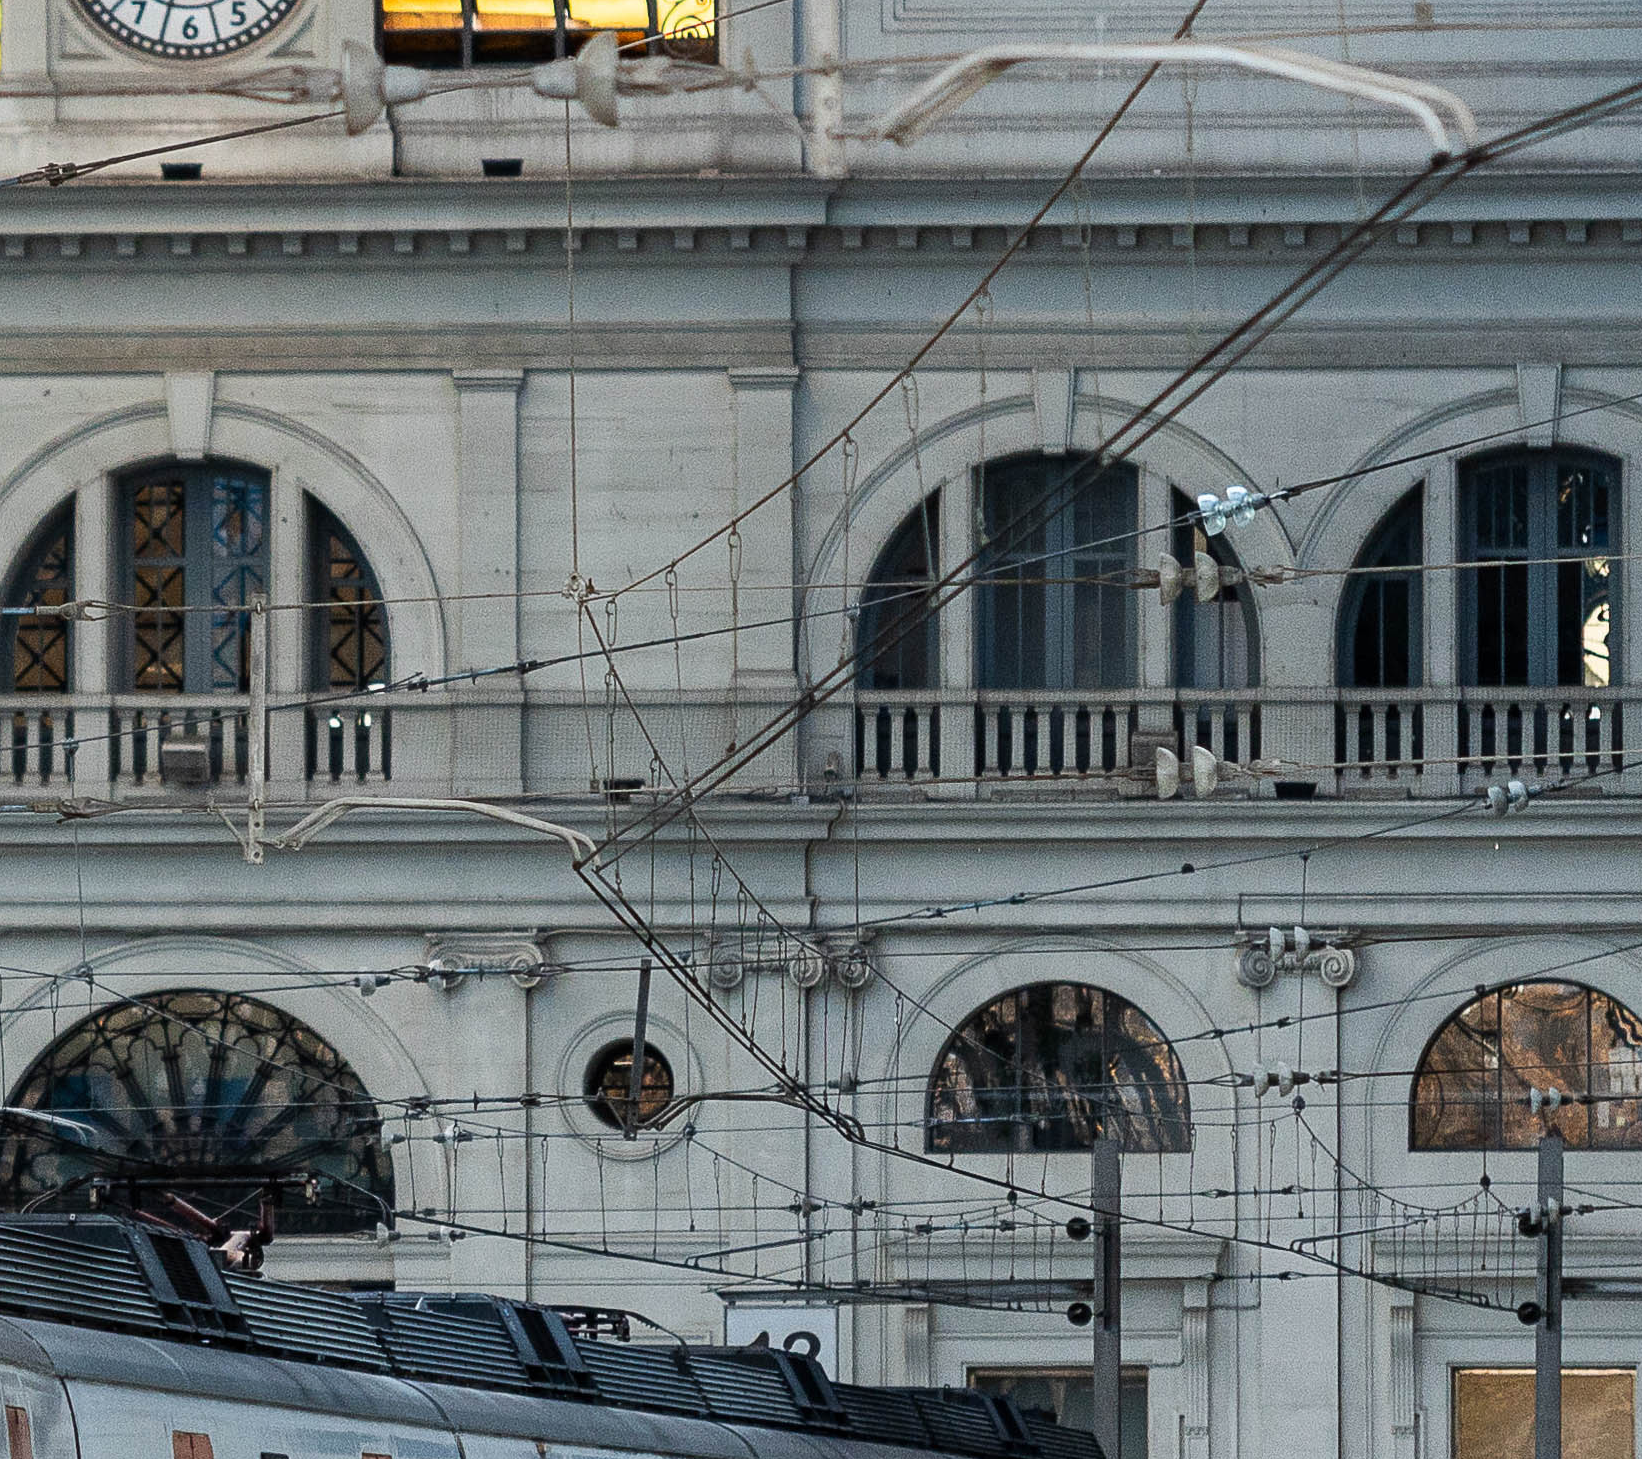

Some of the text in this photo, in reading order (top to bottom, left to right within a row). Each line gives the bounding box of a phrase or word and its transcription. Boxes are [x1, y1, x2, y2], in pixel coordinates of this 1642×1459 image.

[131, 1, 147, 24] 7
[230, 2, 246, 26] 5
[182, 16, 198, 40] 6
